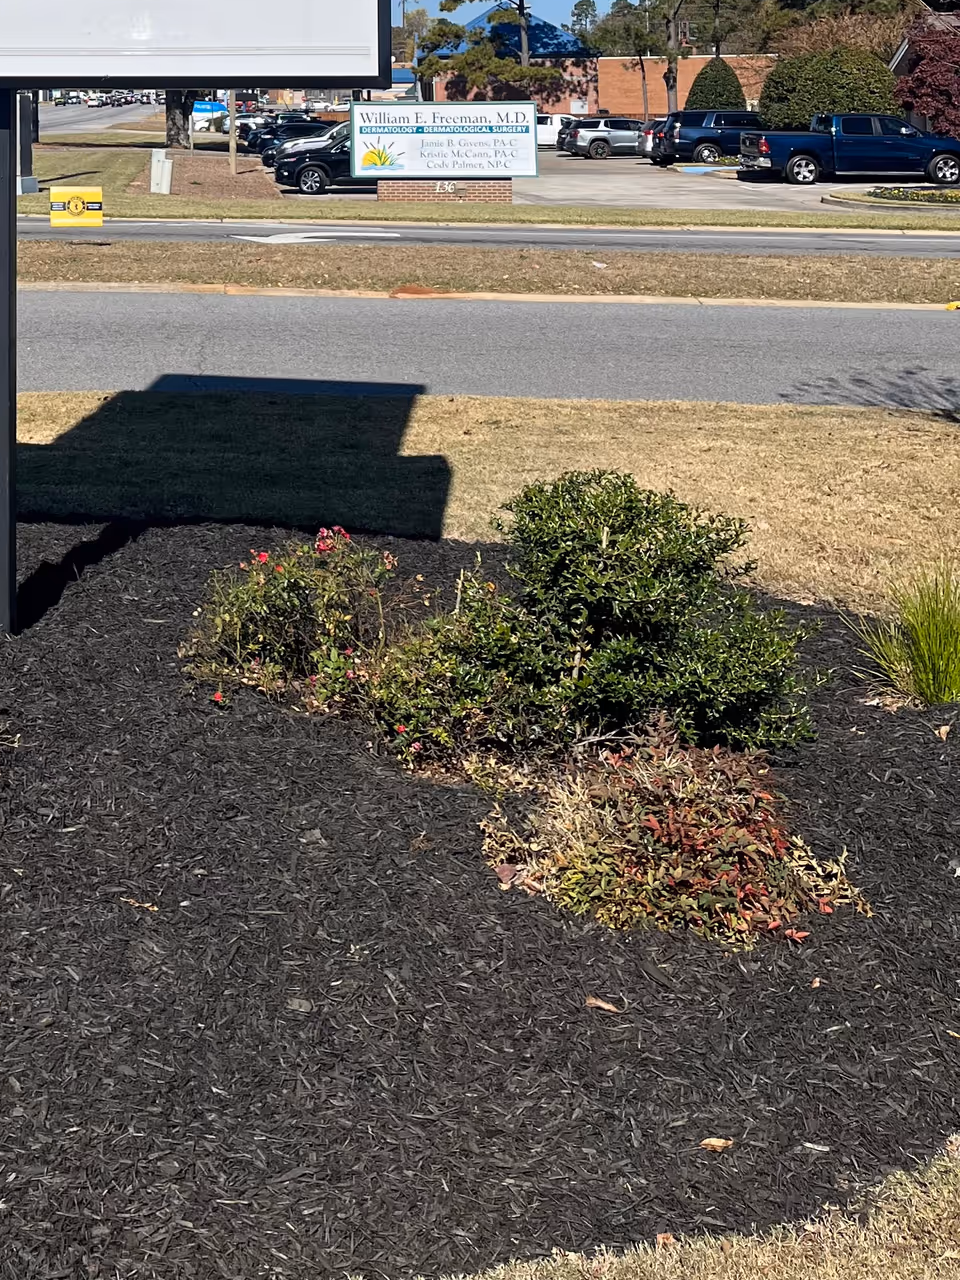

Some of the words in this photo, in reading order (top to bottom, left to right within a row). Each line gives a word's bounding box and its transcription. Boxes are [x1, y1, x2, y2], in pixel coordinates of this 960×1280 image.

[359, 111, 410, 124] William
[414, 111, 427, 124] E.
[431, 111, 491, 124] Freeman,
[496, 111, 529, 124] M.D.
[420, 150, 449, 158] Kristie
[451, 150, 491, 158] McCann,
[494, 150, 518, 158] PA-C
[434, 181, 457, 192] 136
